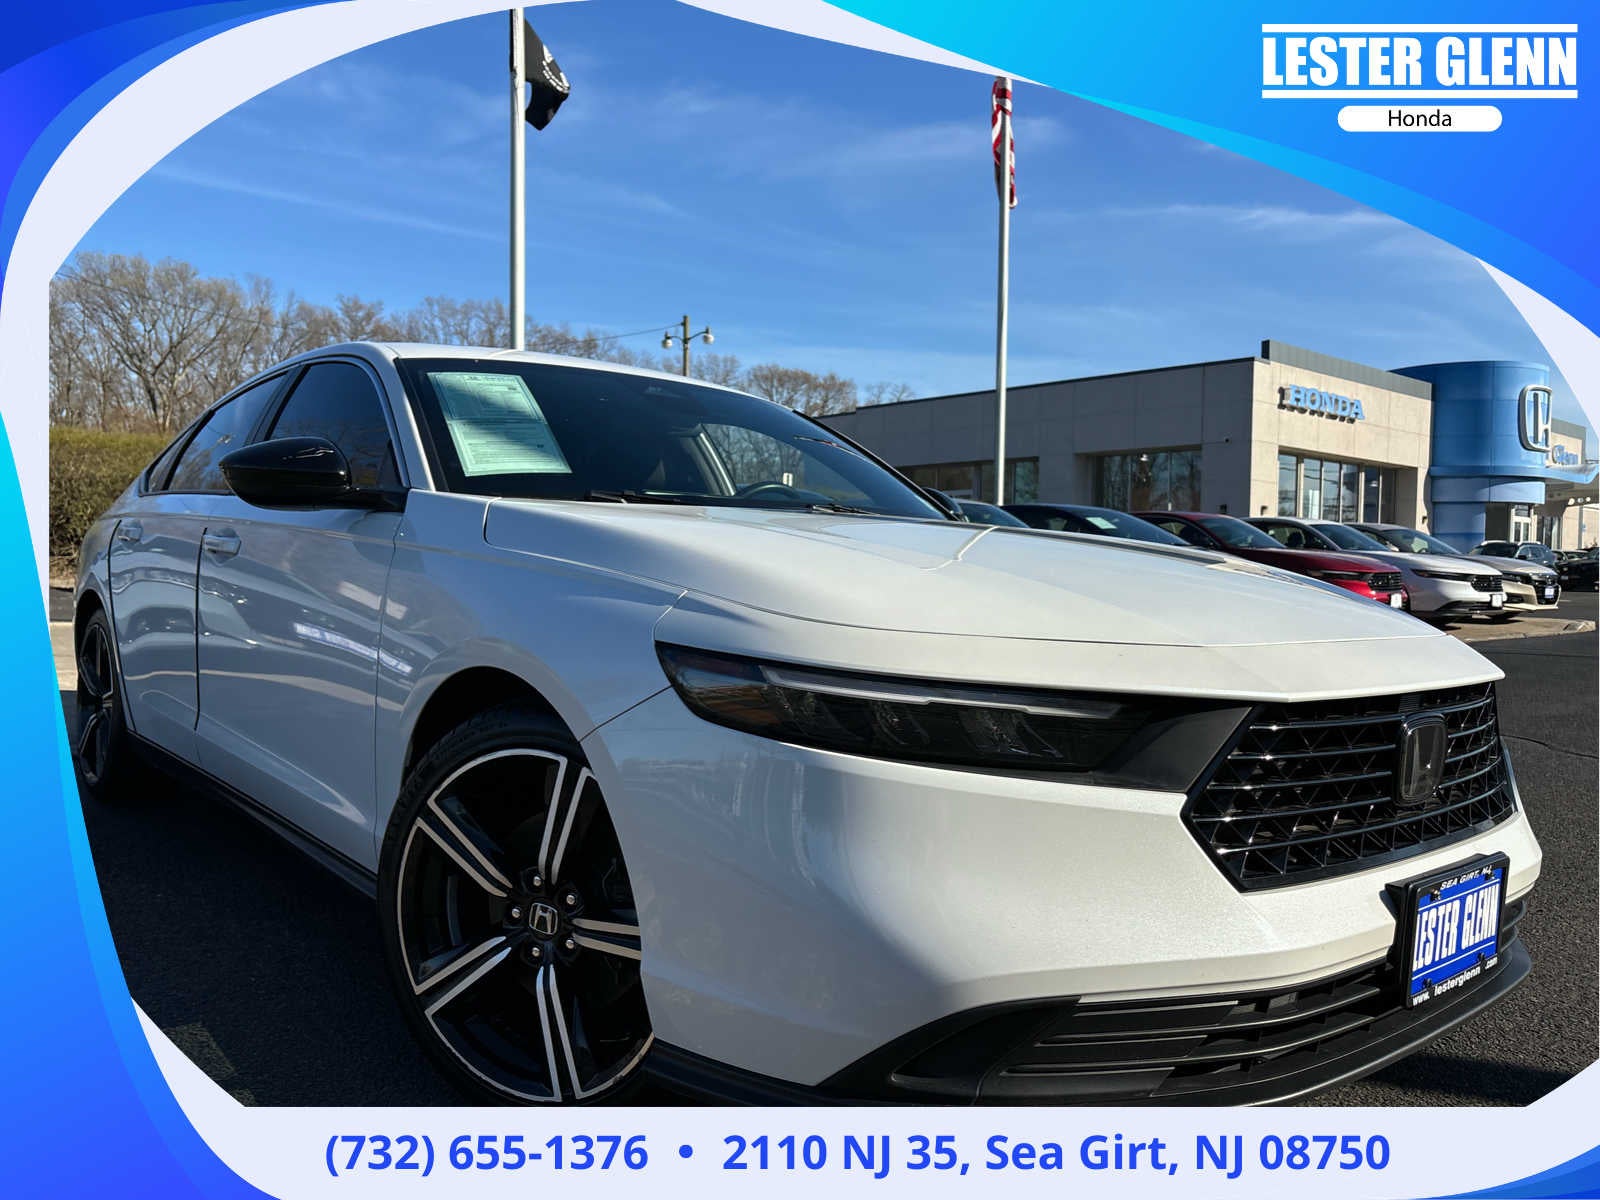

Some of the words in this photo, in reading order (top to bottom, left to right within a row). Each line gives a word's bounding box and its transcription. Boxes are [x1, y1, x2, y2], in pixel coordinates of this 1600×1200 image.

[1288, 384, 1365, 420] HONDA
[1440, 878, 1458, 890] SEA
[1412, 900, 1461, 972] LESTER
[1461, 884, 1500, 950] GLENN
[1434, 966, 1481, 997] lesterglenn
